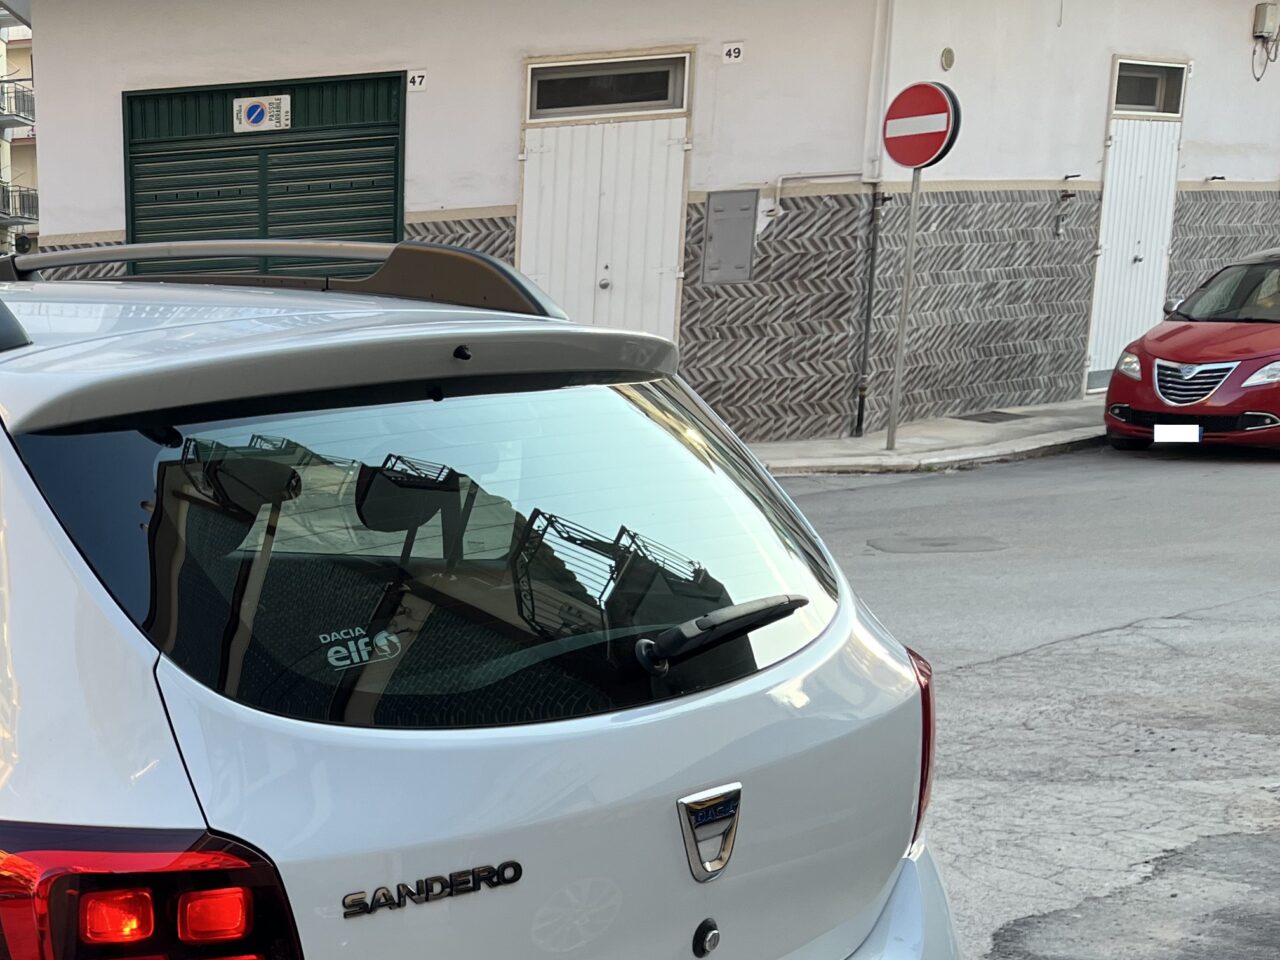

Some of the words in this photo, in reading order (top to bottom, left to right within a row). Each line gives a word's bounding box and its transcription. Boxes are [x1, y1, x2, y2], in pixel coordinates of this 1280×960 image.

[725, 47, 741, 59] 49
[409, 75, 425, 86] 47
[319, 626, 367, 644] DACIA
[327, 637, 372, 667] elf
[342, 860, 523, 919] SANDERO
